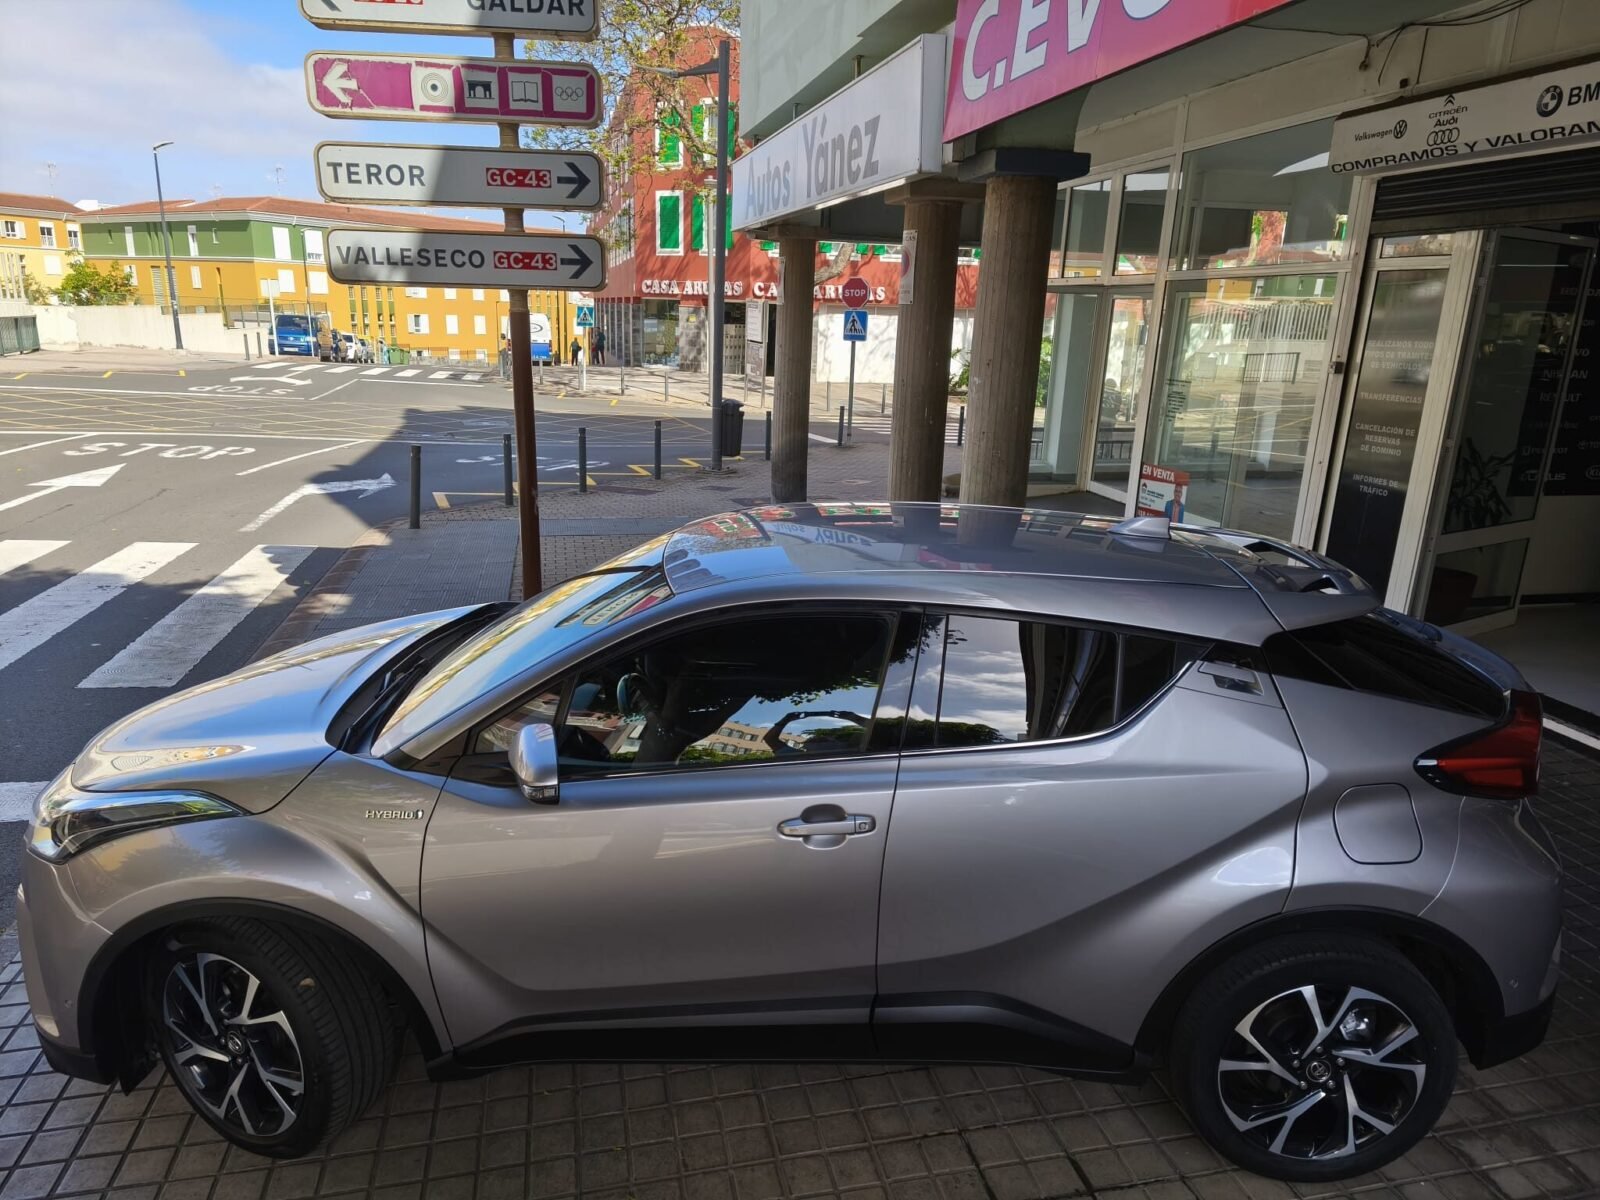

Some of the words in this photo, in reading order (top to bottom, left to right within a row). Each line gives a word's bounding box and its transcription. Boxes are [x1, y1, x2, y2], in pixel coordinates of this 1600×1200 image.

[1433, 116, 1459, 128] Audi
[1354, 128, 1393, 142] Volkswagen
[1331, 145, 1459, 174] COMPRAMOS
[1464, 141, 1479, 153] Y
[745, 157, 791, 220] Autos
[802, 113, 881, 199] Yánez
[326, 161, 426, 187] TEROR
[486, 168, 552, 188] GC-43
[336, 245, 486, 269] VALLESECO
[493, 251, 558, 270] GC-43
[641, 279, 679, 294] CASA
[683, 280, 743, 296] ARUAS
[844, 288, 866, 297] STOP
[187, 384, 296, 396] STOP
[1360, 391, 1422, 404] TRANSFERENCIAS
[1404, 428, 1416, 437] DE
[1364, 434, 1401, 446] RESERVAS
[62, 441, 257, 460] STOP
[1359, 443, 1369, 452] DE
[1370, 445, 1402, 457] DOMINIO
[1142, 464, 1153, 475] EN
[1153, 467, 1176, 483] VENTA
[1352, 473, 1388, 486] INFORMES
[365, 810, 414, 819] HYBRID
